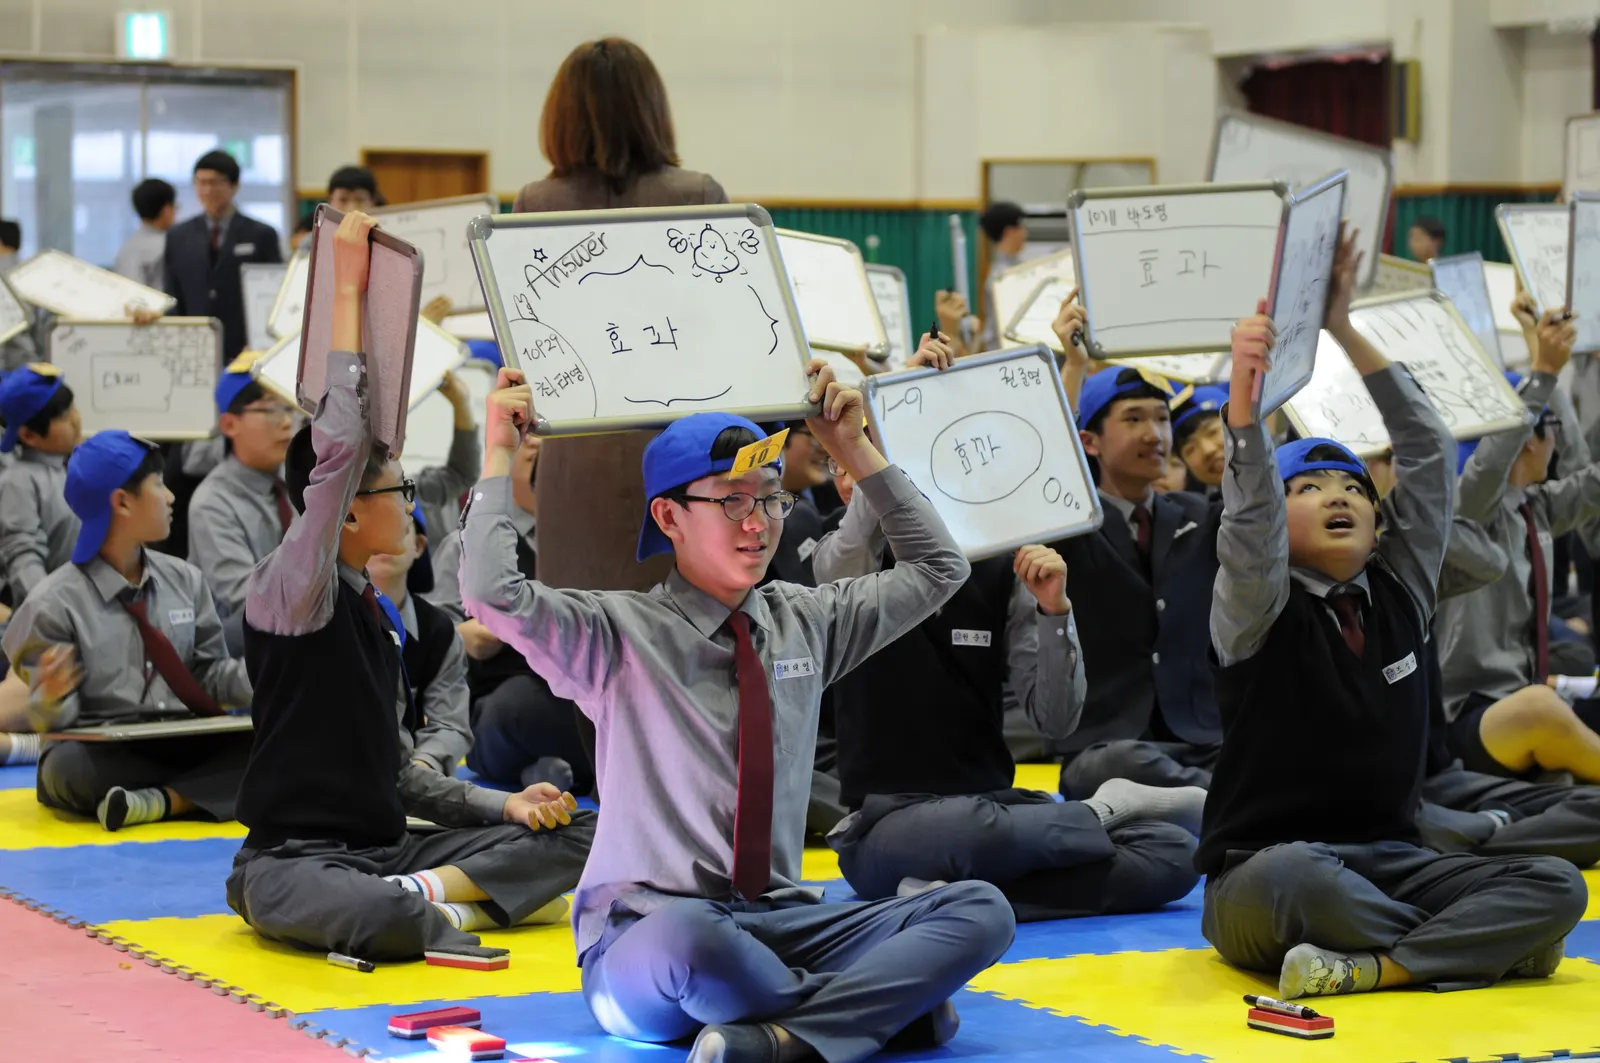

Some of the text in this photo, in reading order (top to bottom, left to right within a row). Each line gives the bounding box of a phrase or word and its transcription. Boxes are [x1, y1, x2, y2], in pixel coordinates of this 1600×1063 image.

[524, 231, 608, 300] Answer
[605, 316, 678, 355] 효과
[747, 447, 769, 468] 10
